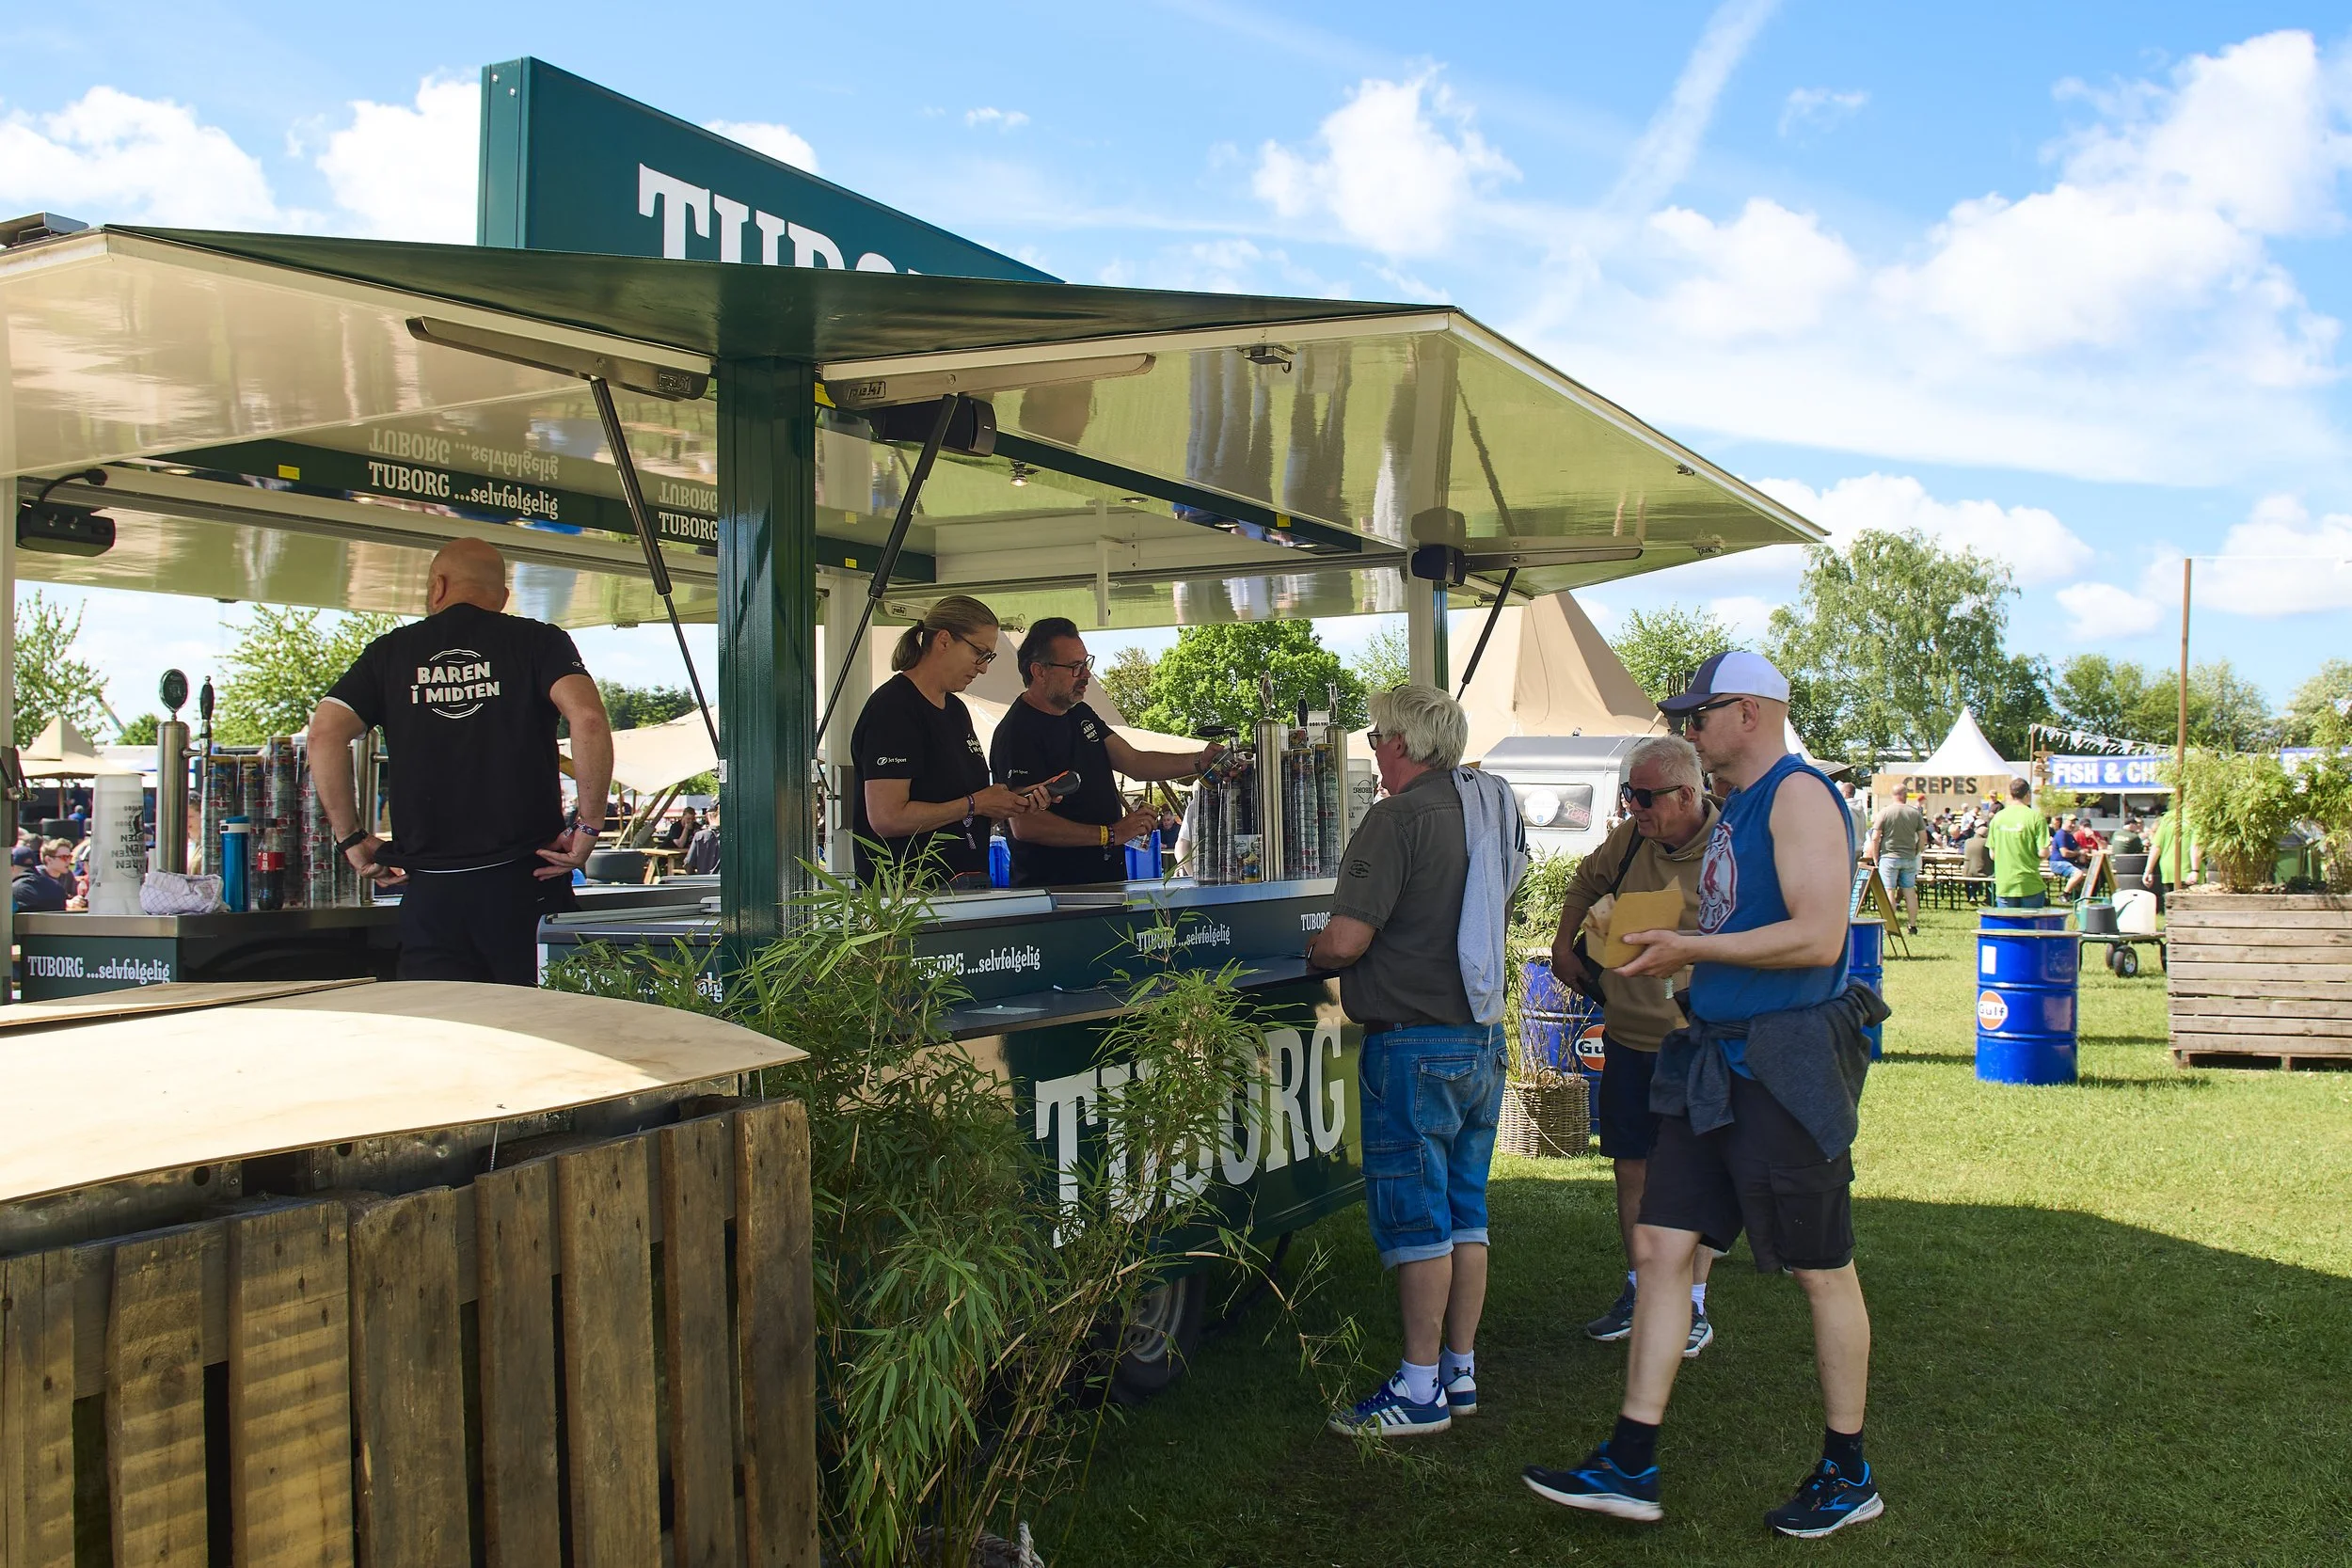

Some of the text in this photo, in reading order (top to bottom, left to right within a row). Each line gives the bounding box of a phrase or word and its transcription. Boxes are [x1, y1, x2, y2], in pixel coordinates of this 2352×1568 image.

[368, 461, 560, 520] TUBORG ...selvfølgelig
[659, 511, 718, 541] TUBORG
[416, 661, 491, 685] BAREN
[425, 681, 501, 704] MIDTEN
[2052, 762, 2099, 784] FISH
[2104, 762, 2122, 784] &
[1902, 776, 1978, 795] CREPES
[1300, 911, 1331, 931] TUBORG
[27, 955, 170, 985] TUBORG ...selvfølgelig
[911, 944, 1041, 980] ORG ...selvfølgelig
[1979, 1004, 2006, 1016] Gulf
[1578, 1040, 1604, 1054] Gu
